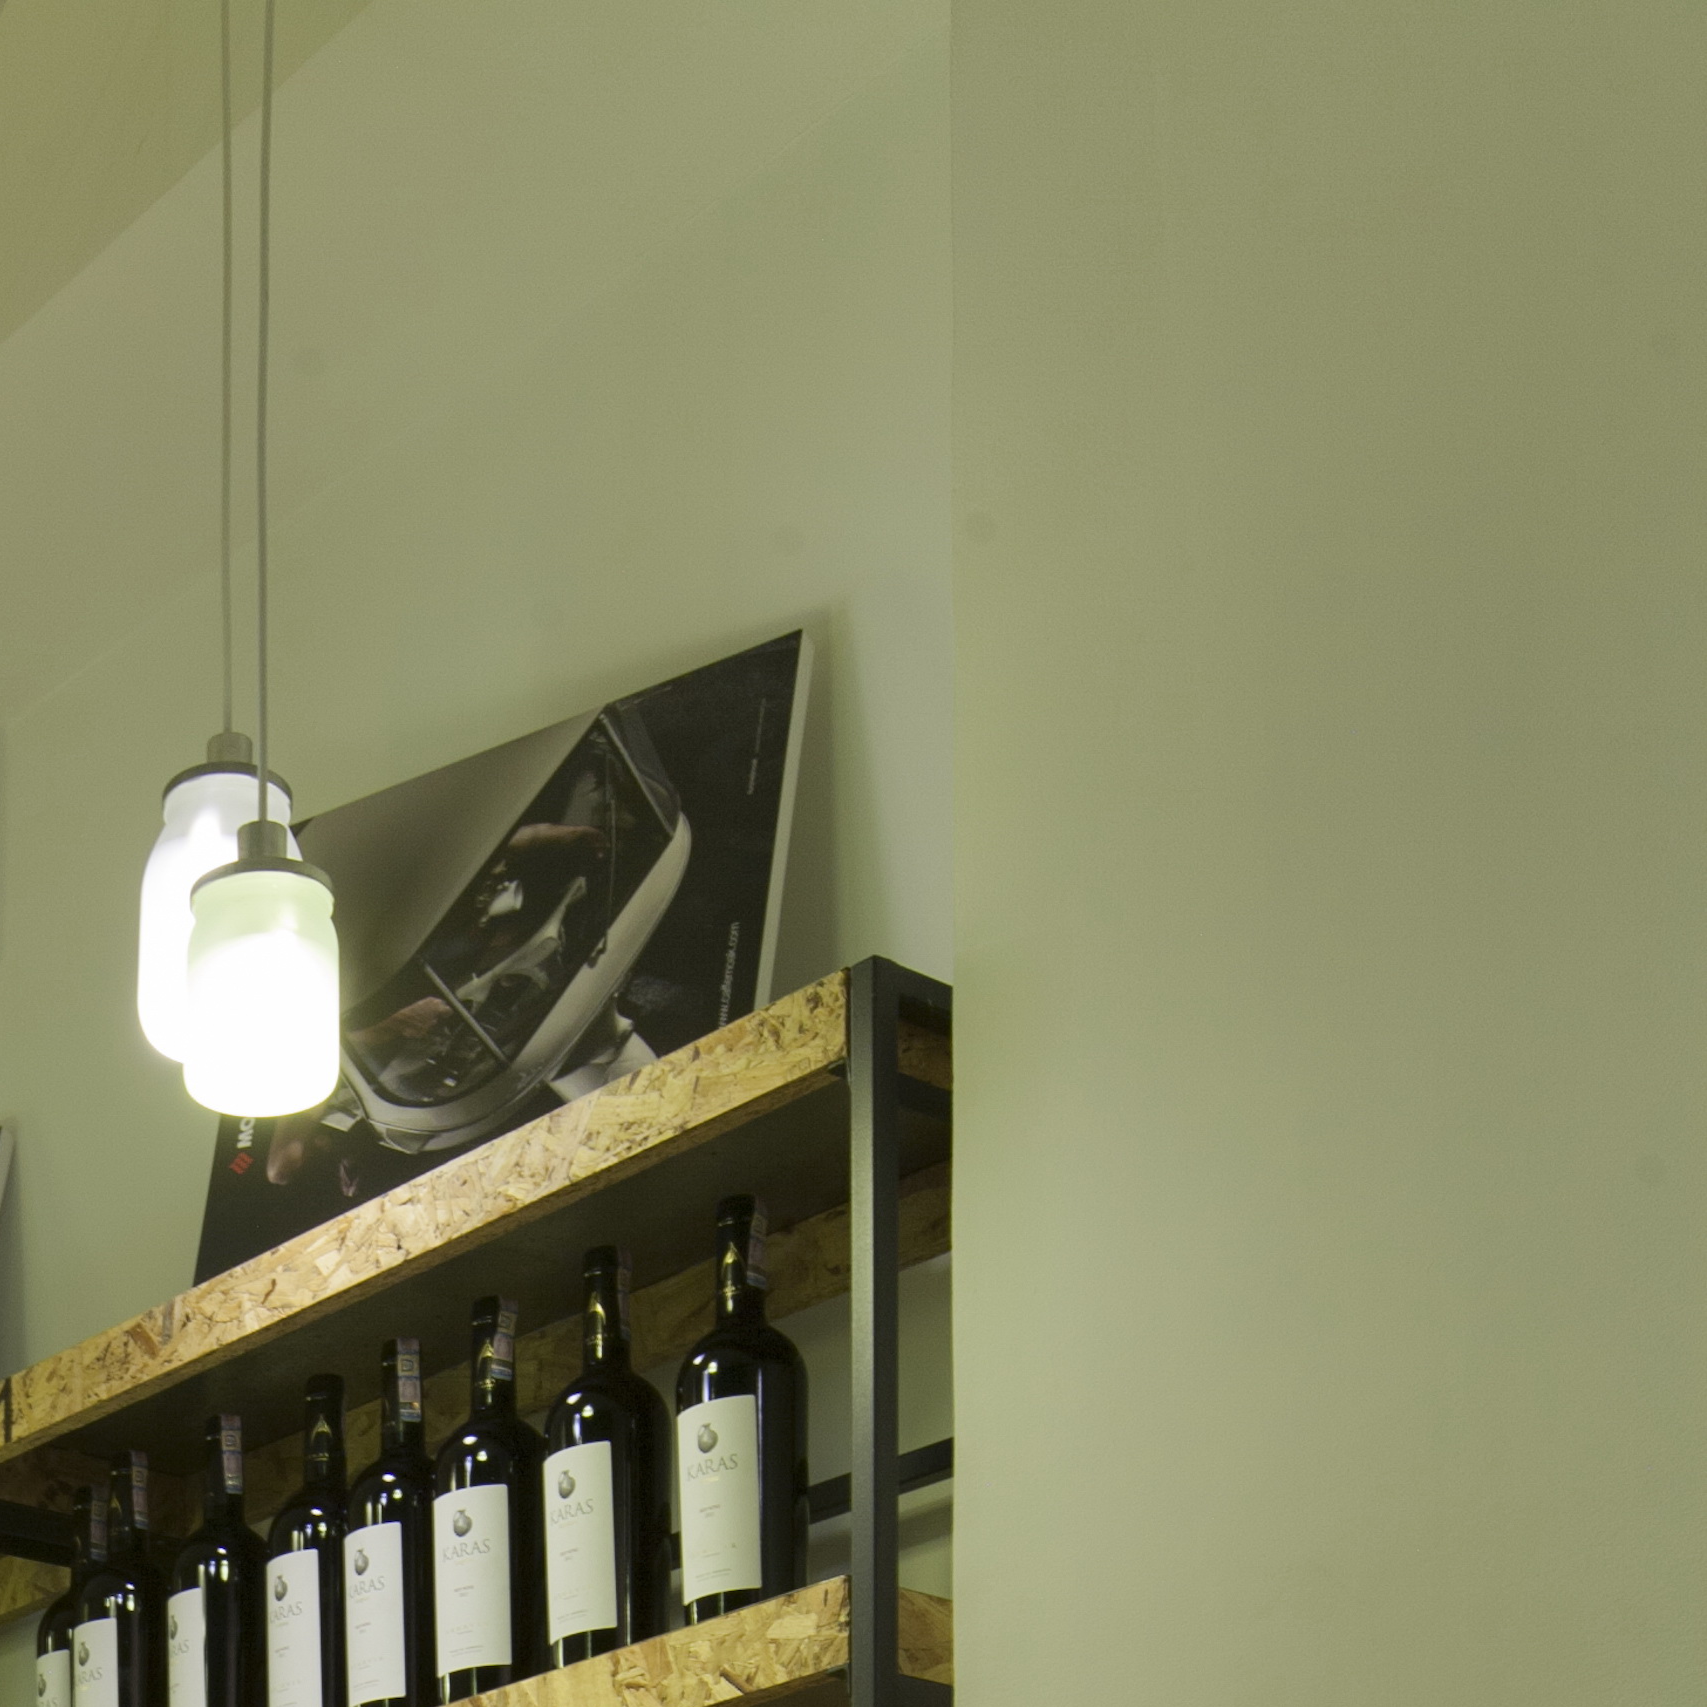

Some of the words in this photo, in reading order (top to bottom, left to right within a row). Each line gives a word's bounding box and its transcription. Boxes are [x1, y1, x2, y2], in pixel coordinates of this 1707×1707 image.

[237, 1117, 256, 1148] MO
[686, 1453, 739, 1481] KARAS
[549, 1498, 595, 1526] KARAS
[442, 1538, 491, 1562] KARAS
